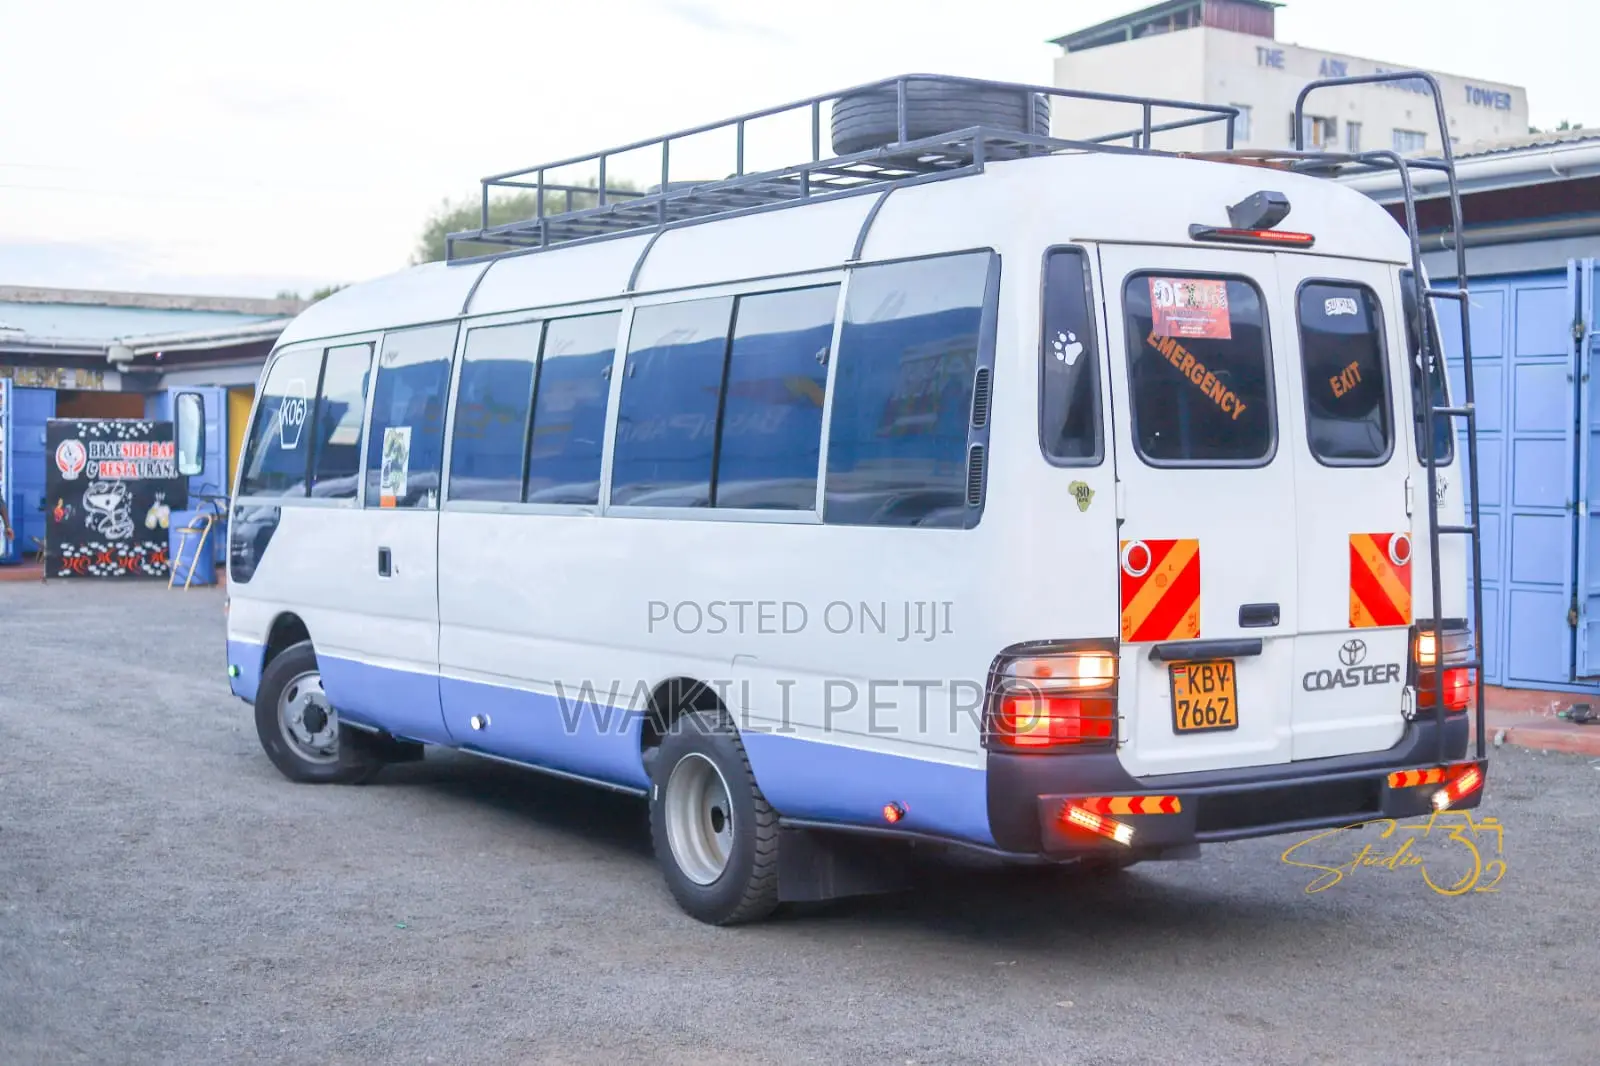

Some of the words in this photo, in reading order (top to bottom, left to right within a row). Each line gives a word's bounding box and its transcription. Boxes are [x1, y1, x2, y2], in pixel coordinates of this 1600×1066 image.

[1256, 46, 1285, 70] THE
[1318, 57, 1349, 78] ARK
[1464, 84, 1512, 111] TOWER
[1147, 331, 1247, 421] EMERGENCY
[1329, 360, 1362, 399] EXIT
[1076, 486, 1090, 497] 80
[1188, 664, 1229, 695] KBY
[1302, 663, 1401, 692] COASTER
[1178, 696, 1232, 728] 766Z
